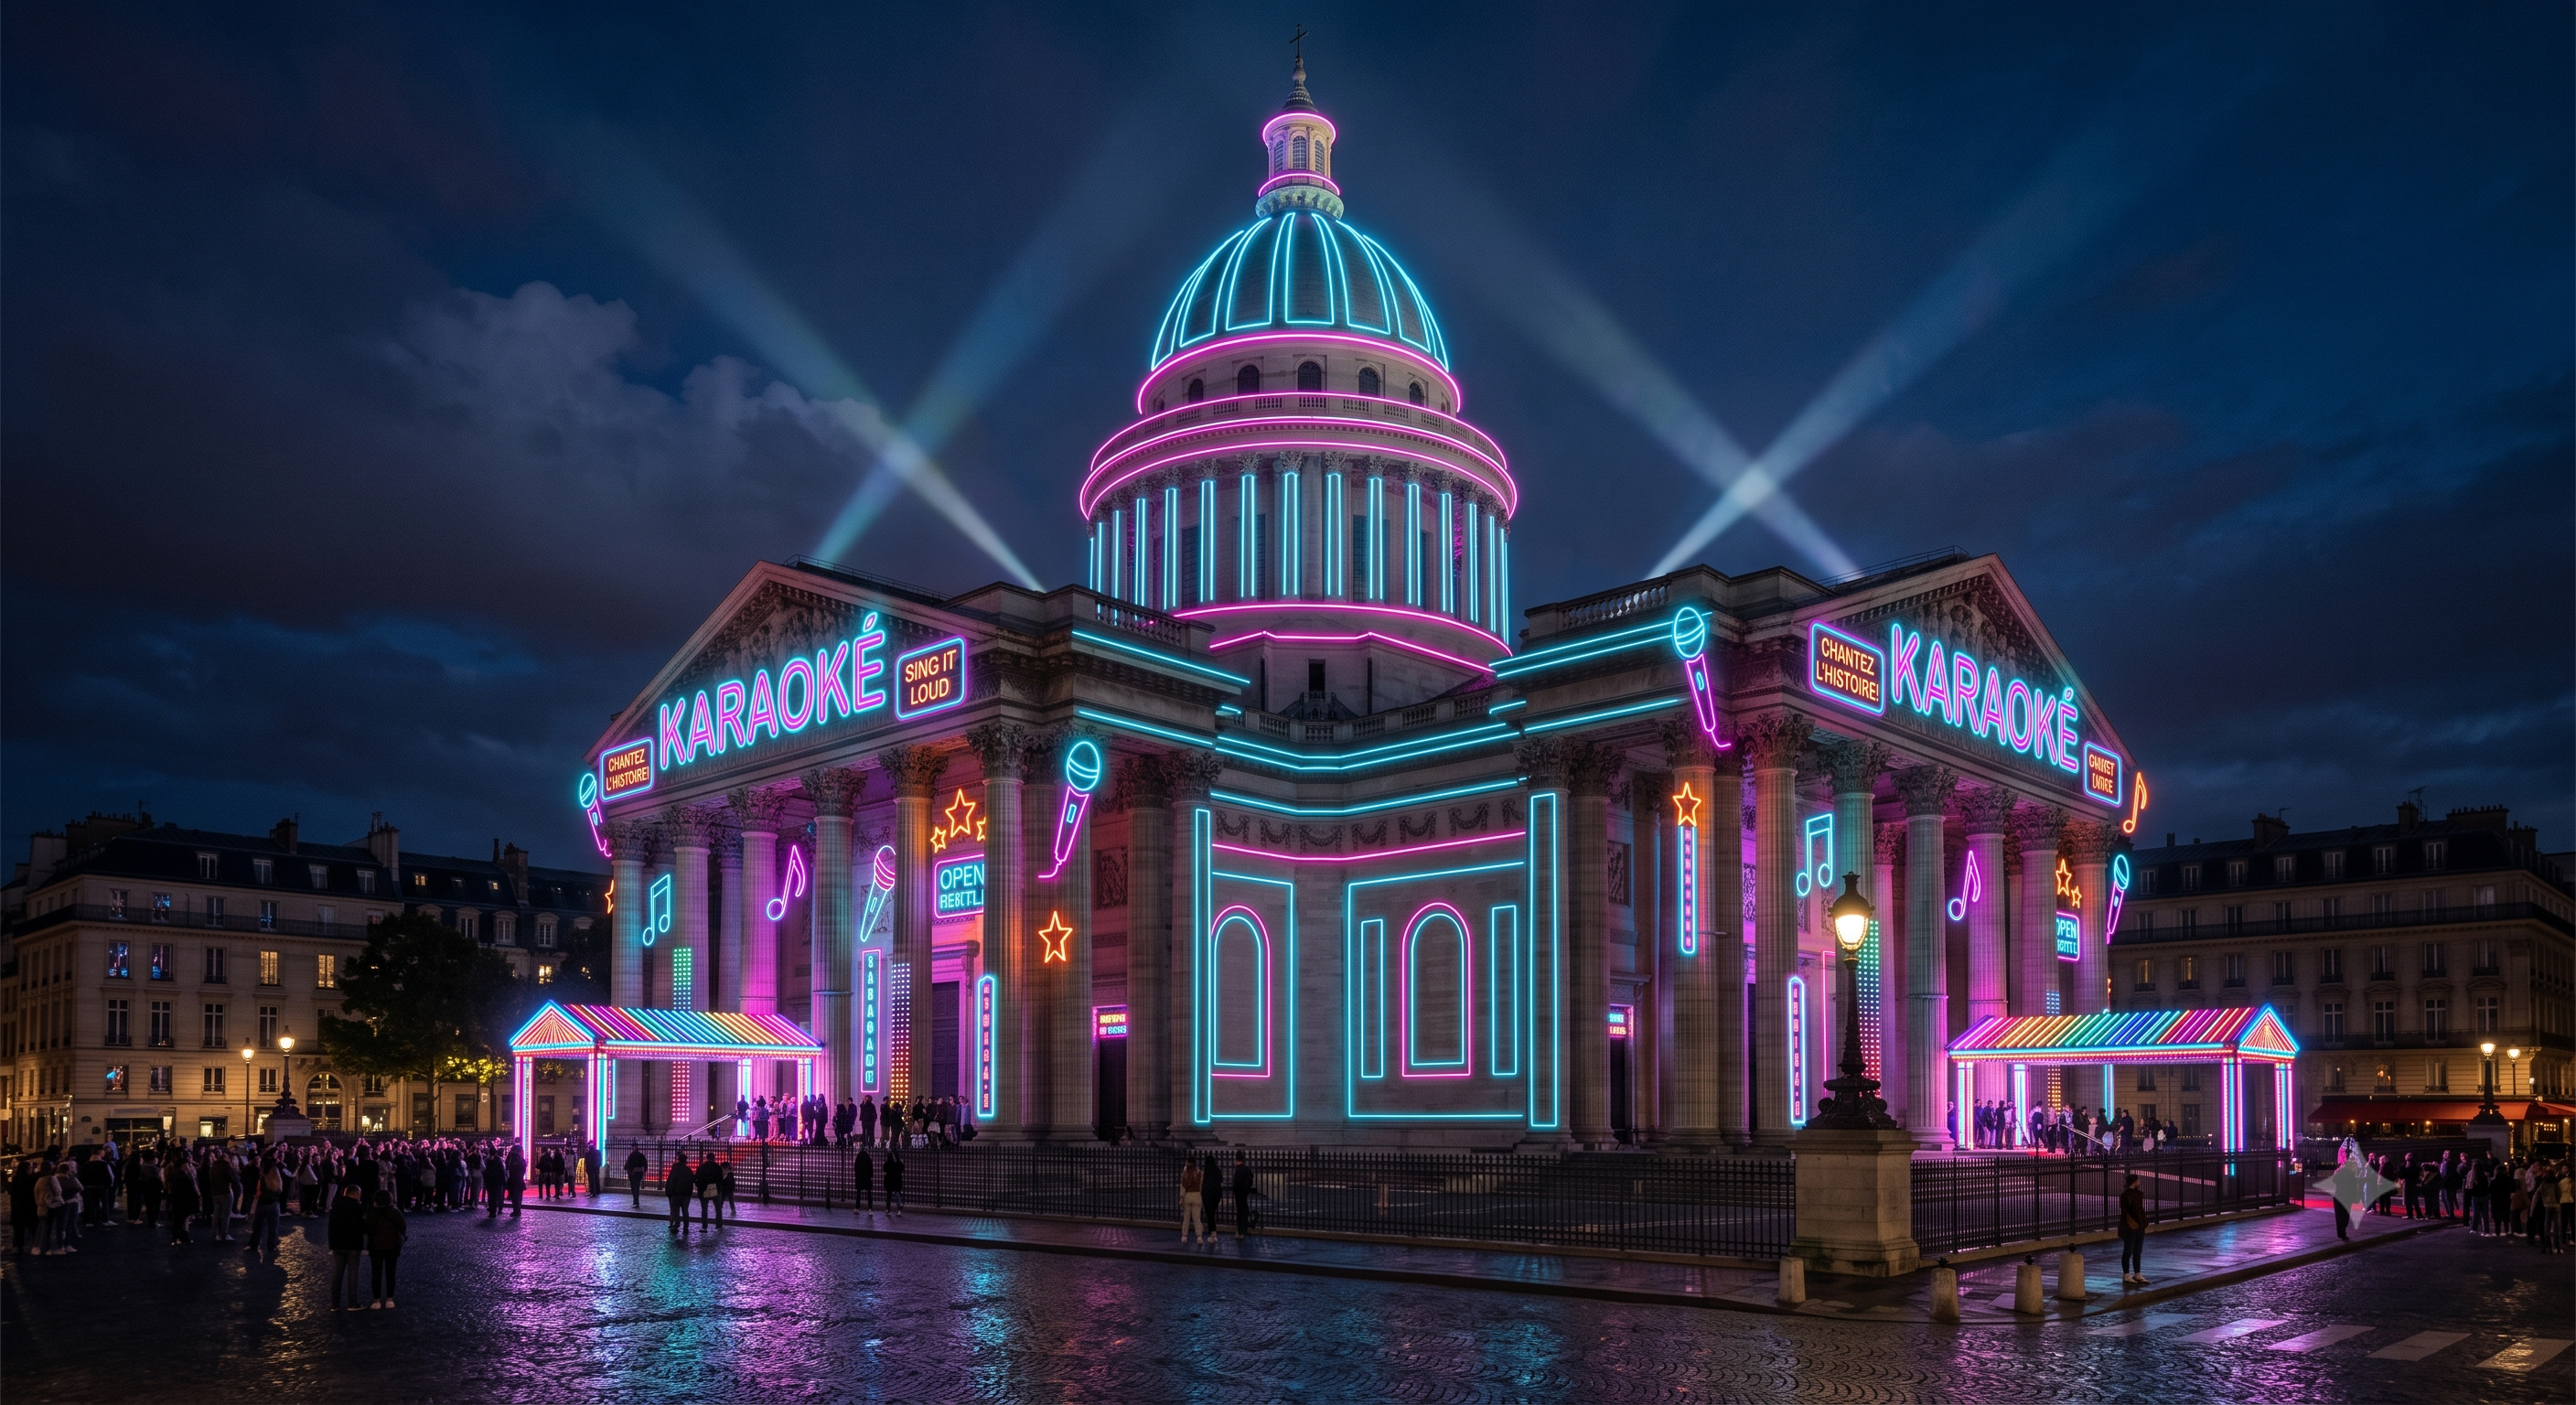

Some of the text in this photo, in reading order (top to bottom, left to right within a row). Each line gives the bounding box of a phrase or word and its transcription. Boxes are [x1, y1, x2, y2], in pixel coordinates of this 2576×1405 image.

[905, 649, 957, 682] SING IT
[1821, 638, 1875, 676] CHANTEZ
[660, 612, 886, 770] KARAOKÉ
[910, 678, 950, 705] LOUD
[1816, 660, 1879, 702] L'HISTOIRE!
[1891, 624, 2078, 773] KARAOKÉ
[608, 748, 645, 772] CHANTEZ
[606, 766, 649, 791] L'HISTOIRE!
[940, 863, 984, 889] OPEN
